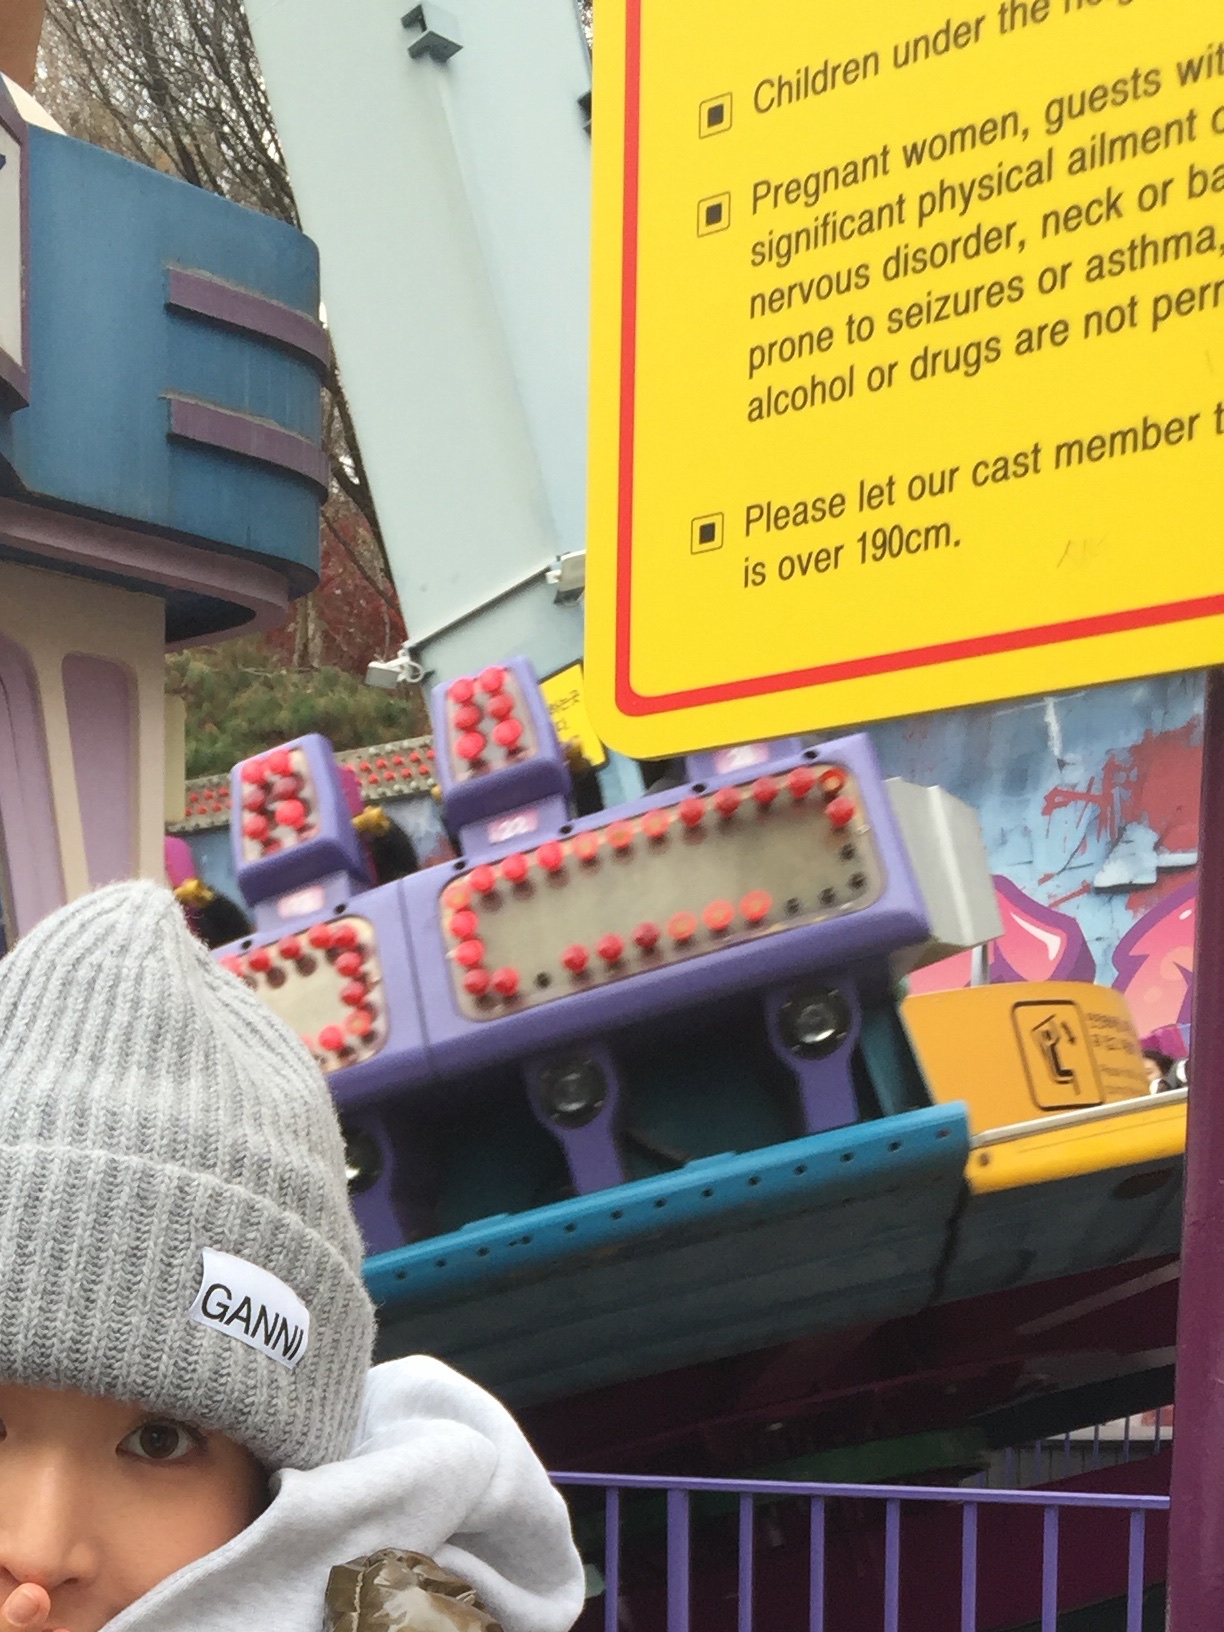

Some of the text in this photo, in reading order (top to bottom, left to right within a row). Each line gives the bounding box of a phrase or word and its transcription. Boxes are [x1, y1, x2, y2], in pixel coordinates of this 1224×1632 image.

[753, 0, 1050, 114] Children under the
[750, 193, 906, 269] significant
[918, 146, 1053, 229] physical
[1067, 109, 1198, 176] ailment
[752, 144, 890, 216] Pregnant
[902, 111, 1029, 169] women,
[1044, 67, 1162, 136] guests
[750, 263, 870, 320] nervous
[882, 221, 1026, 282] disorder,
[1041, 186, 1123, 240] neck
[1137, 177, 1175, 212] or
[747, 364, 854, 423] alcohol
[867, 361, 899, 392] or
[910, 336, 1002, 382] drugs
[1014, 319, 1070, 356] are
[1083, 295, 1139, 340] not
[748, 326, 834, 380] prone
[845, 314, 875, 345] to
[887, 275, 1025, 334] seizures
[1037, 261, 1073, 295] or
[745, 493, 846, 538] Please
[858, 475, 896, 512] let
[907, 466, 960, 502] our
[971, 442, 1042, 487] cast
[1054, 412, 1201, 470] member
[744, 522, 961, 589] is over 190cm.
[201, 1283, 304, 1361] GANNI
